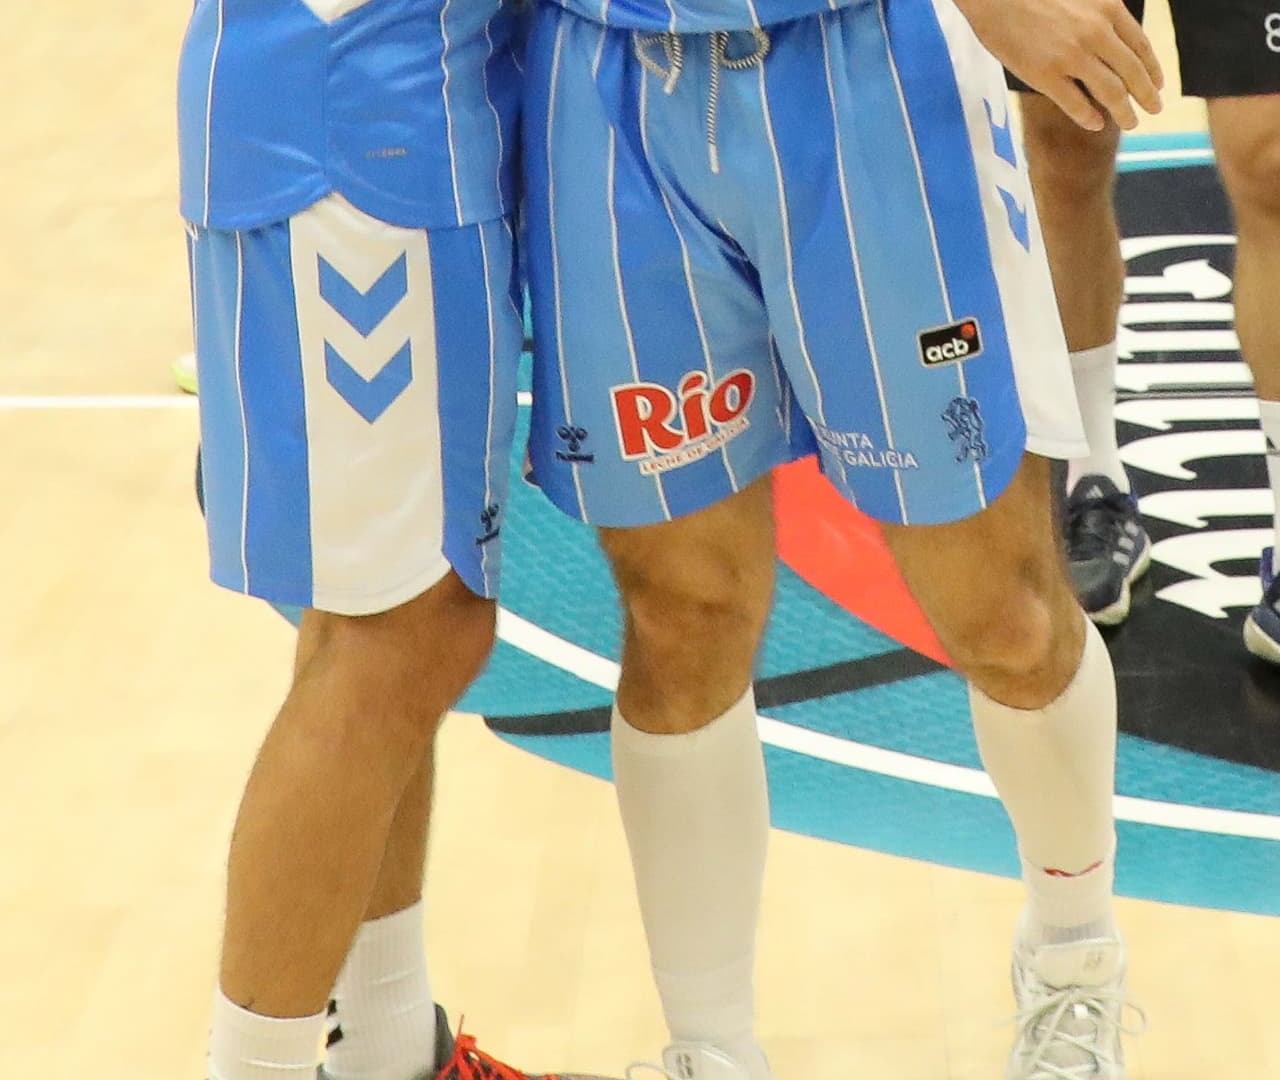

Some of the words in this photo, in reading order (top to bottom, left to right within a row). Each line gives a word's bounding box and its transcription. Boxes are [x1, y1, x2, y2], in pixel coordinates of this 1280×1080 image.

[925, 337, 969, 362] acb
[614, 372, 754, 457] Río
[842, 450, 919, 469] GALICIA
